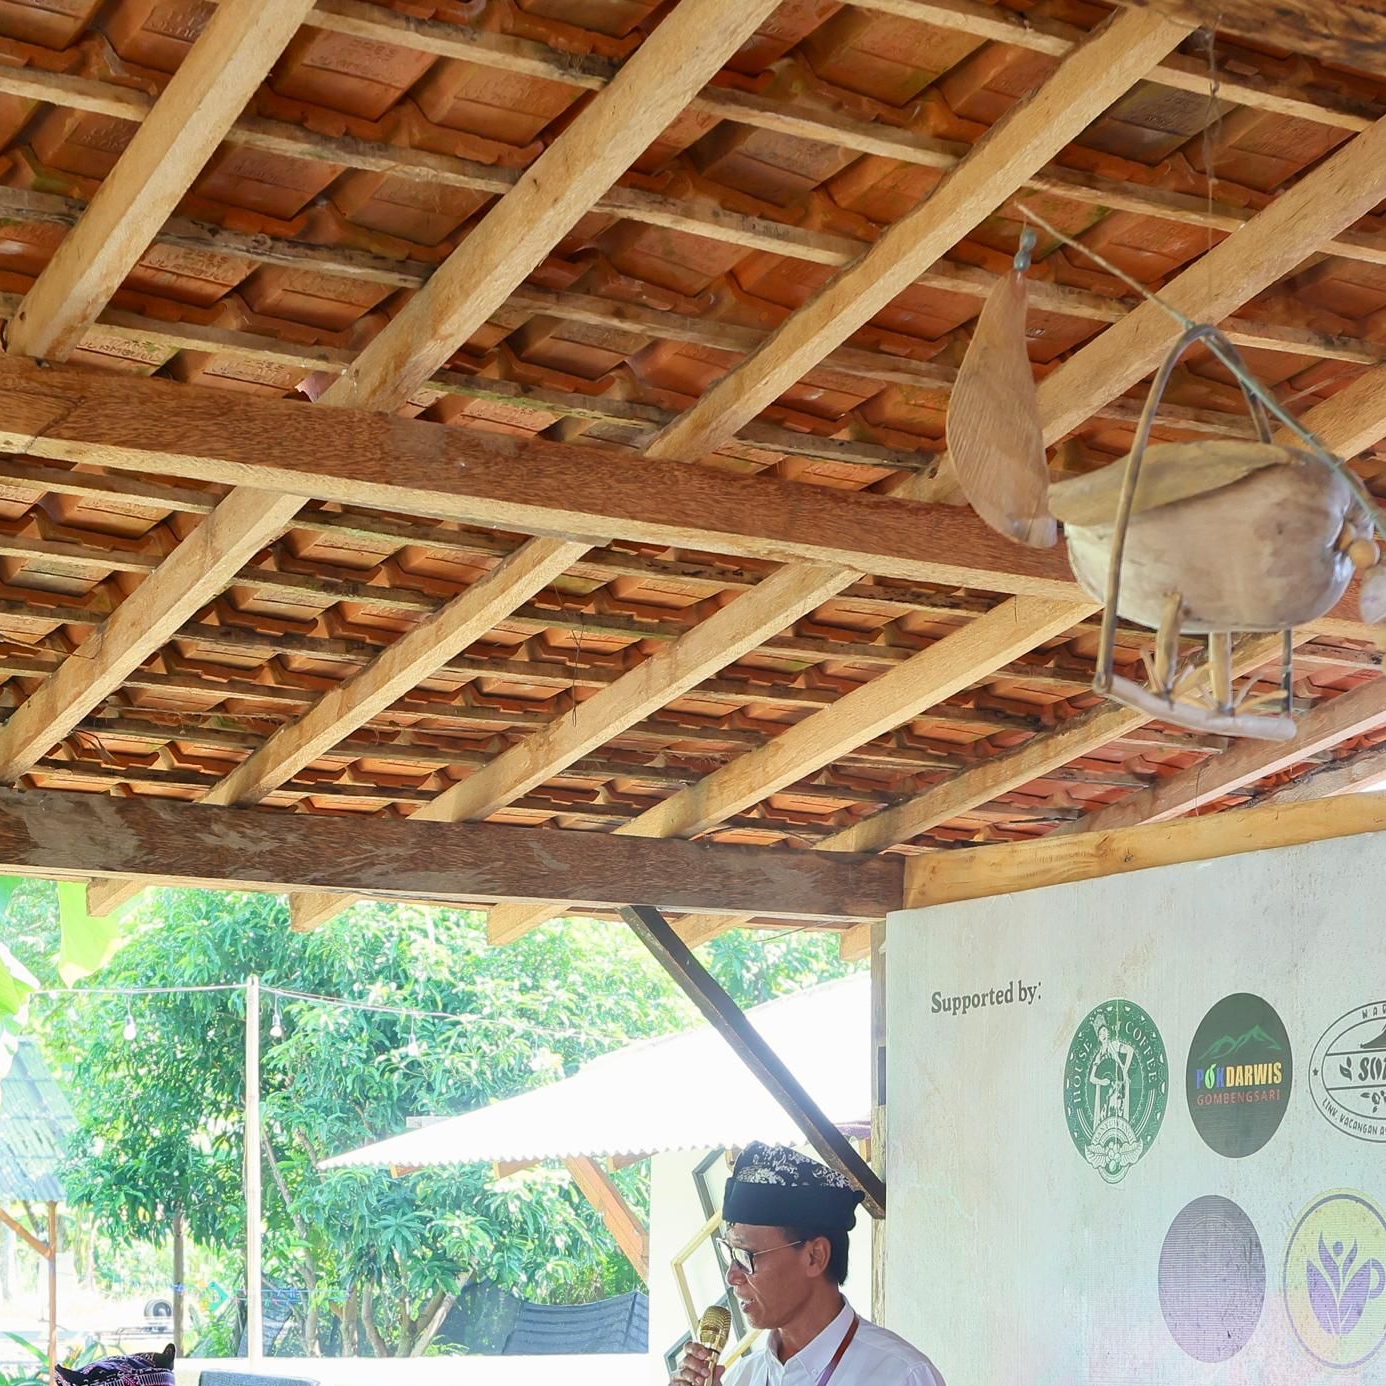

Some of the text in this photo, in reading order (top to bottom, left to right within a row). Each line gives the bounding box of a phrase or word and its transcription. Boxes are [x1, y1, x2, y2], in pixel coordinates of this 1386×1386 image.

[931, 979, 1041, 1016] Supported by:
[1073, 1020, 1158, 1103] HOUSE COFFEE
[1196, 1062, 1282, 1089] POKDARWIS
[1197, 1088, 1281, 1106] GOMBENGSARI
